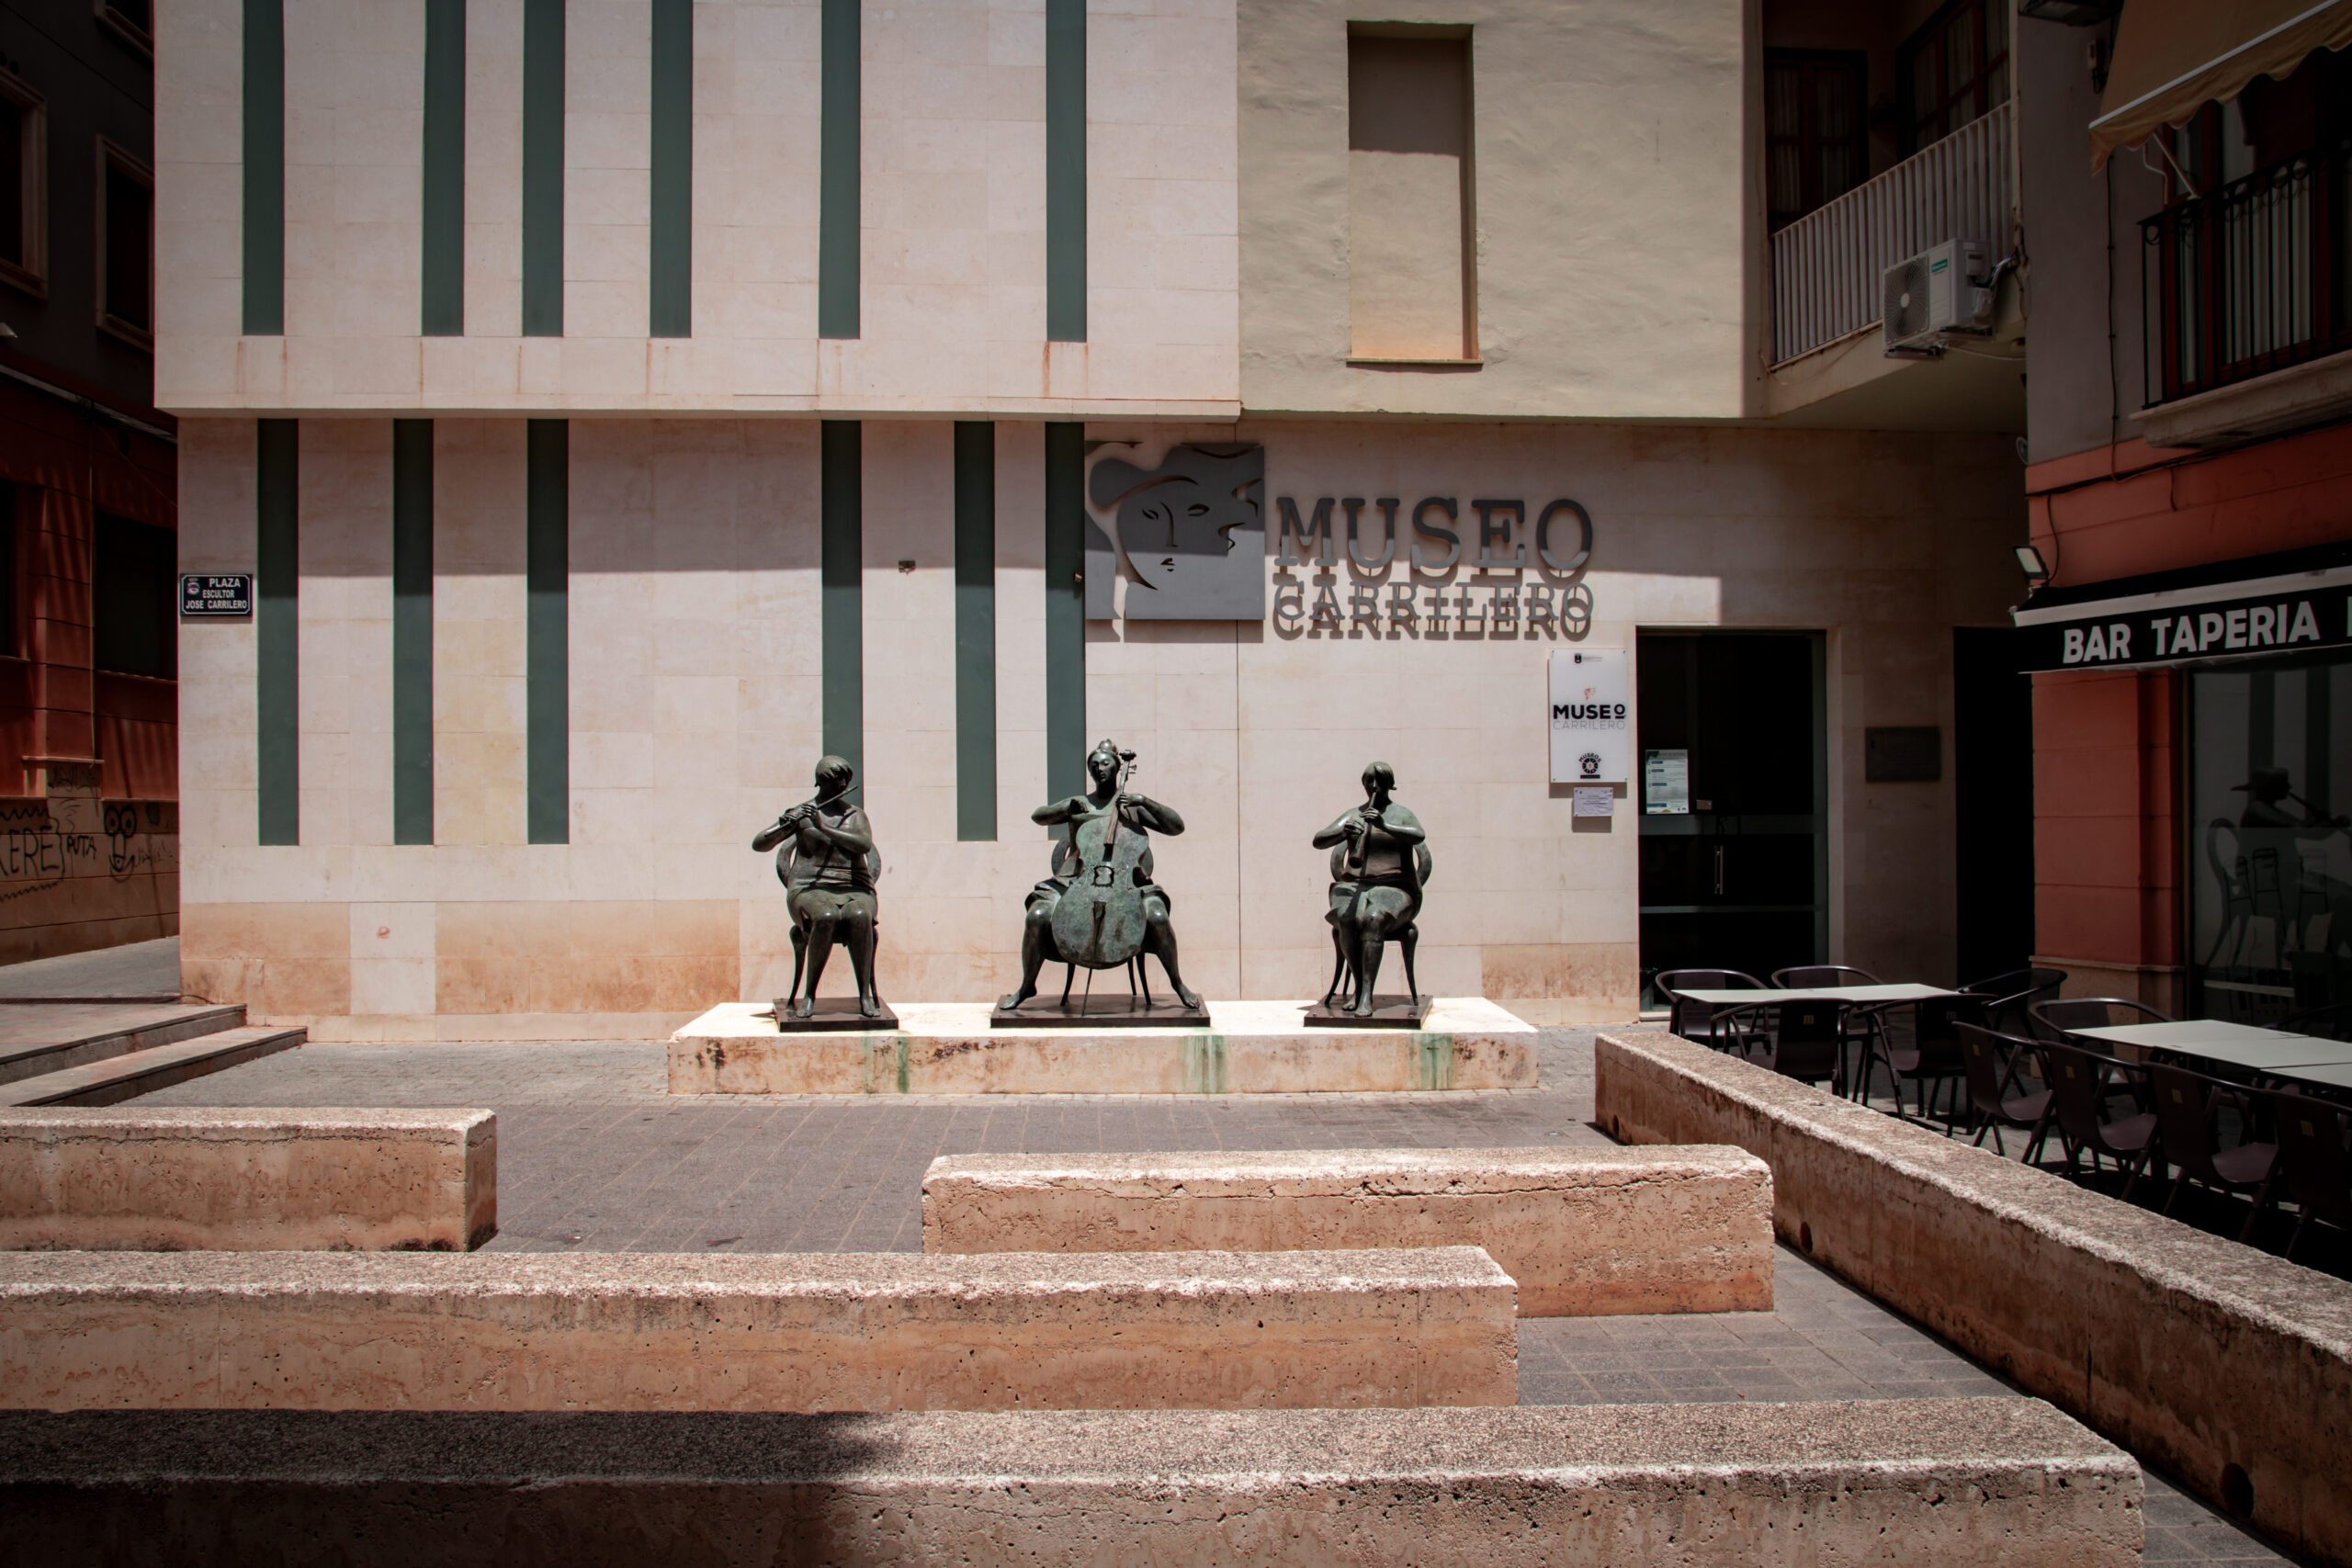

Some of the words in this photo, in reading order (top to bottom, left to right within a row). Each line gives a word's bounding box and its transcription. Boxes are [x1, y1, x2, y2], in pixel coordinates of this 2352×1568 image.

[1273, 497, 1593, 570] MUSEO
[209, 578, 241, 588] PLAZA
[202, 589, 235, 599] ESCULTOR
[1274, 581, 1594, 622] CARRILERO
[186, 600, 204, 609] JOSE
[208, 600, 247, 609] CARRILERO
[2063, 623, 2132, 664] BAR
[2151, 601, 2321, 656] TAPERIA
[1553, 704, 1626, 720] MUSEO
[1553, 720, 1626, 731] CARRILERO
[0, 825, 59, 877] ERE
